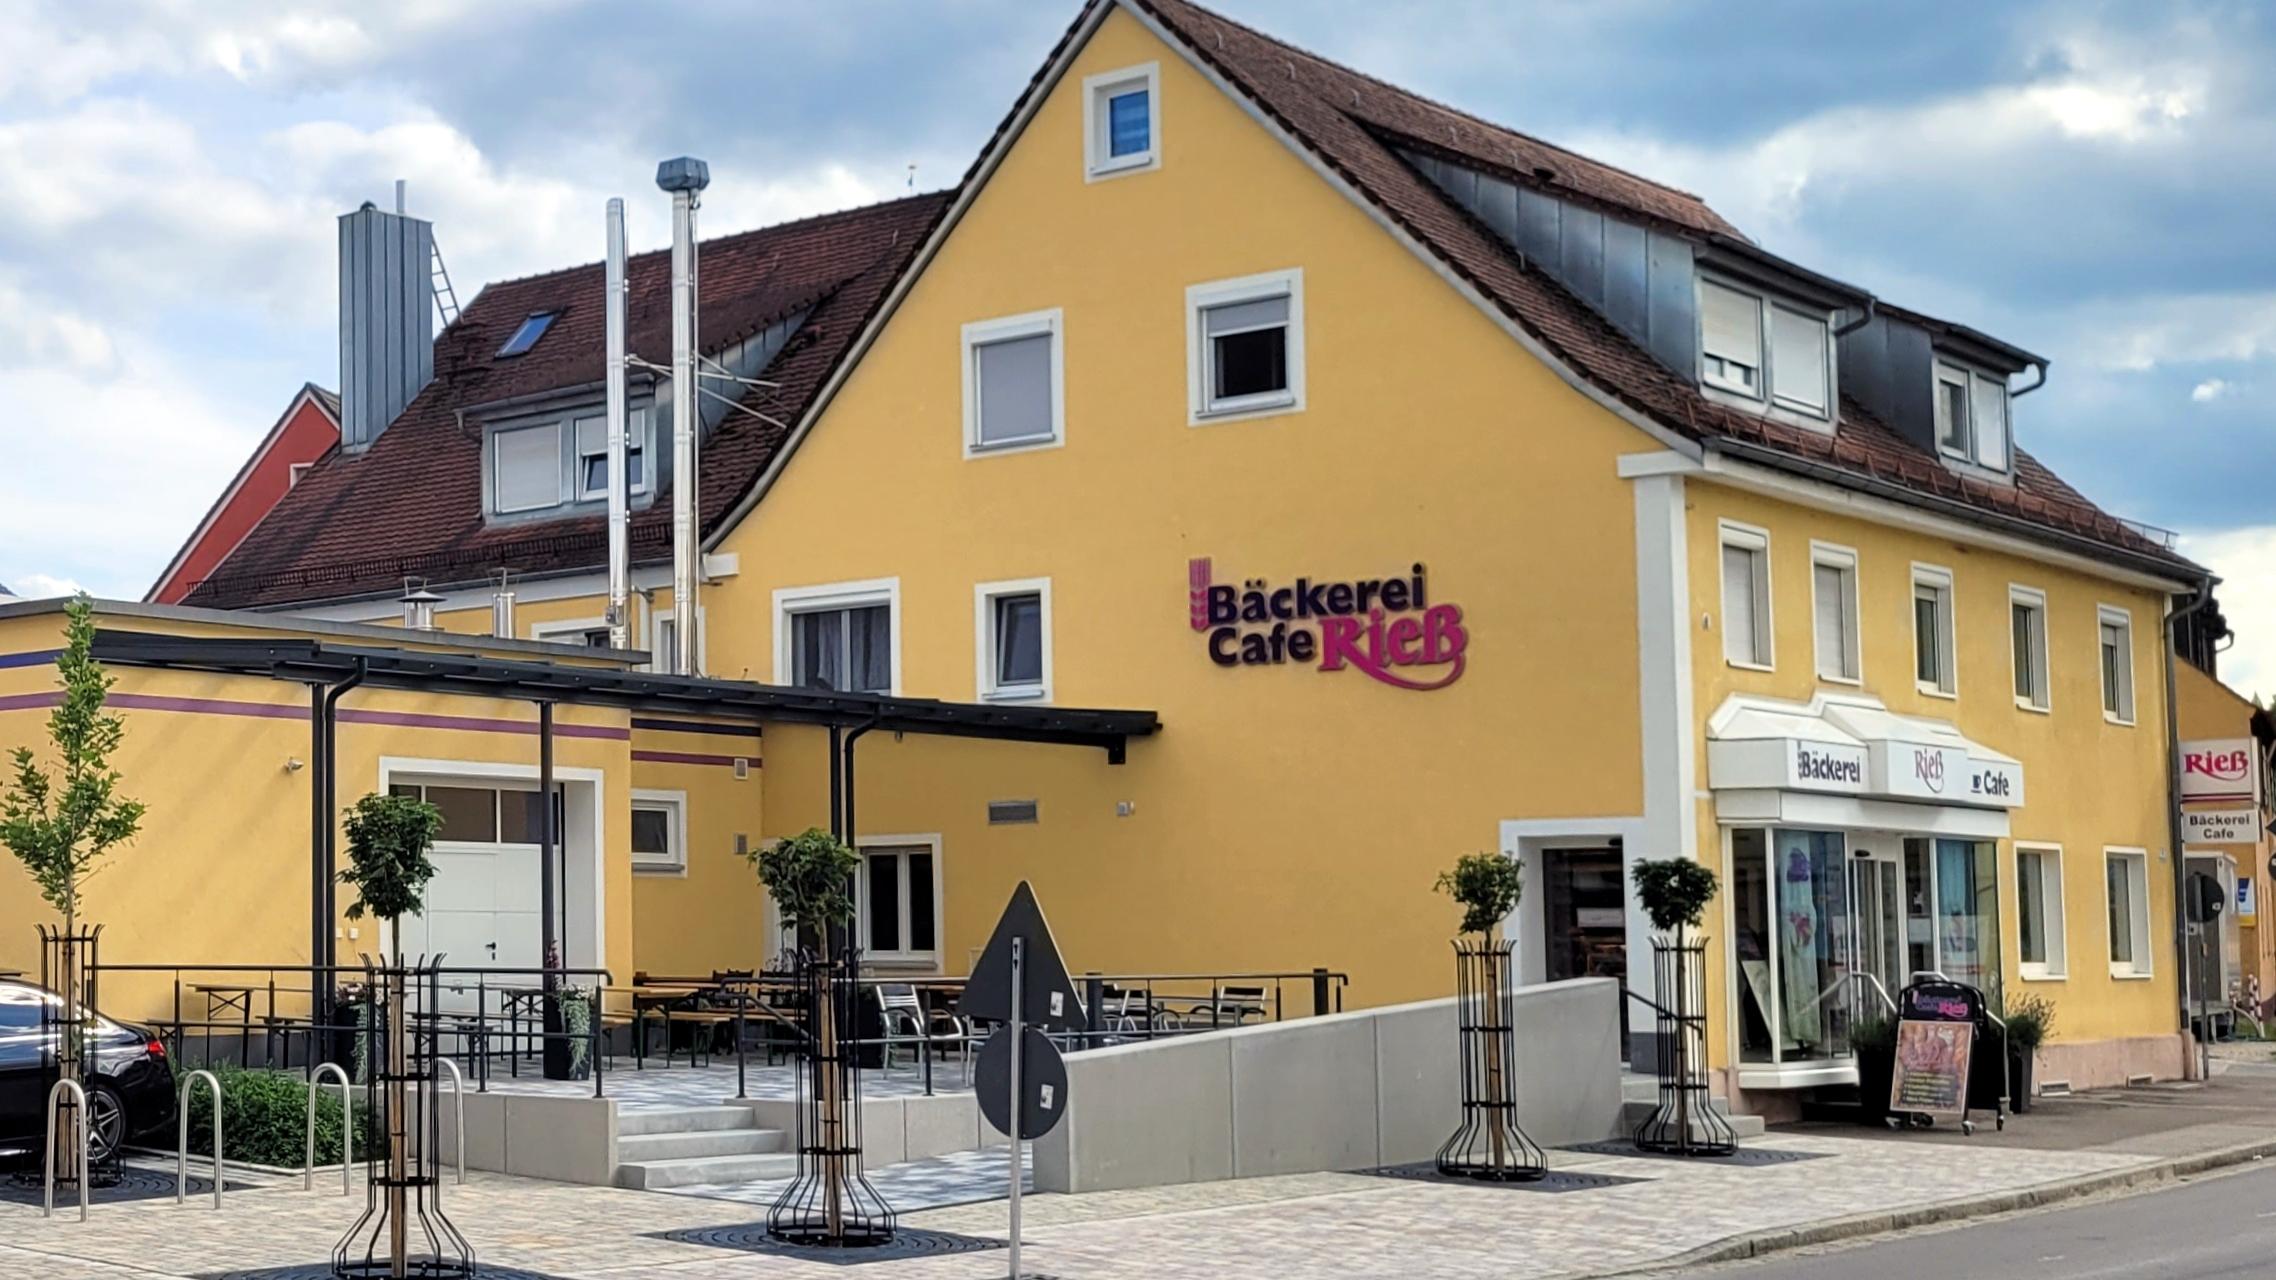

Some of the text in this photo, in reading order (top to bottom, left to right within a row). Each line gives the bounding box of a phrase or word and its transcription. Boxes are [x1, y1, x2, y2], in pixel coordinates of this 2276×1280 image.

[1208, 562, 1426, 623] Bäckerei
[1208, 604, 1469, 691] Cafe Rieß
[1802, 751, 1861, 783] Bäckerei
[1914, 748, 1944, 794] Rieß
[2184, 750, 2249, 782] Rieß
[1983, 770, 2009, 797] Cafe
[2189, 813, 2250, 827] Bäckerei
[2203, 828, 2234, 839] Cafe
